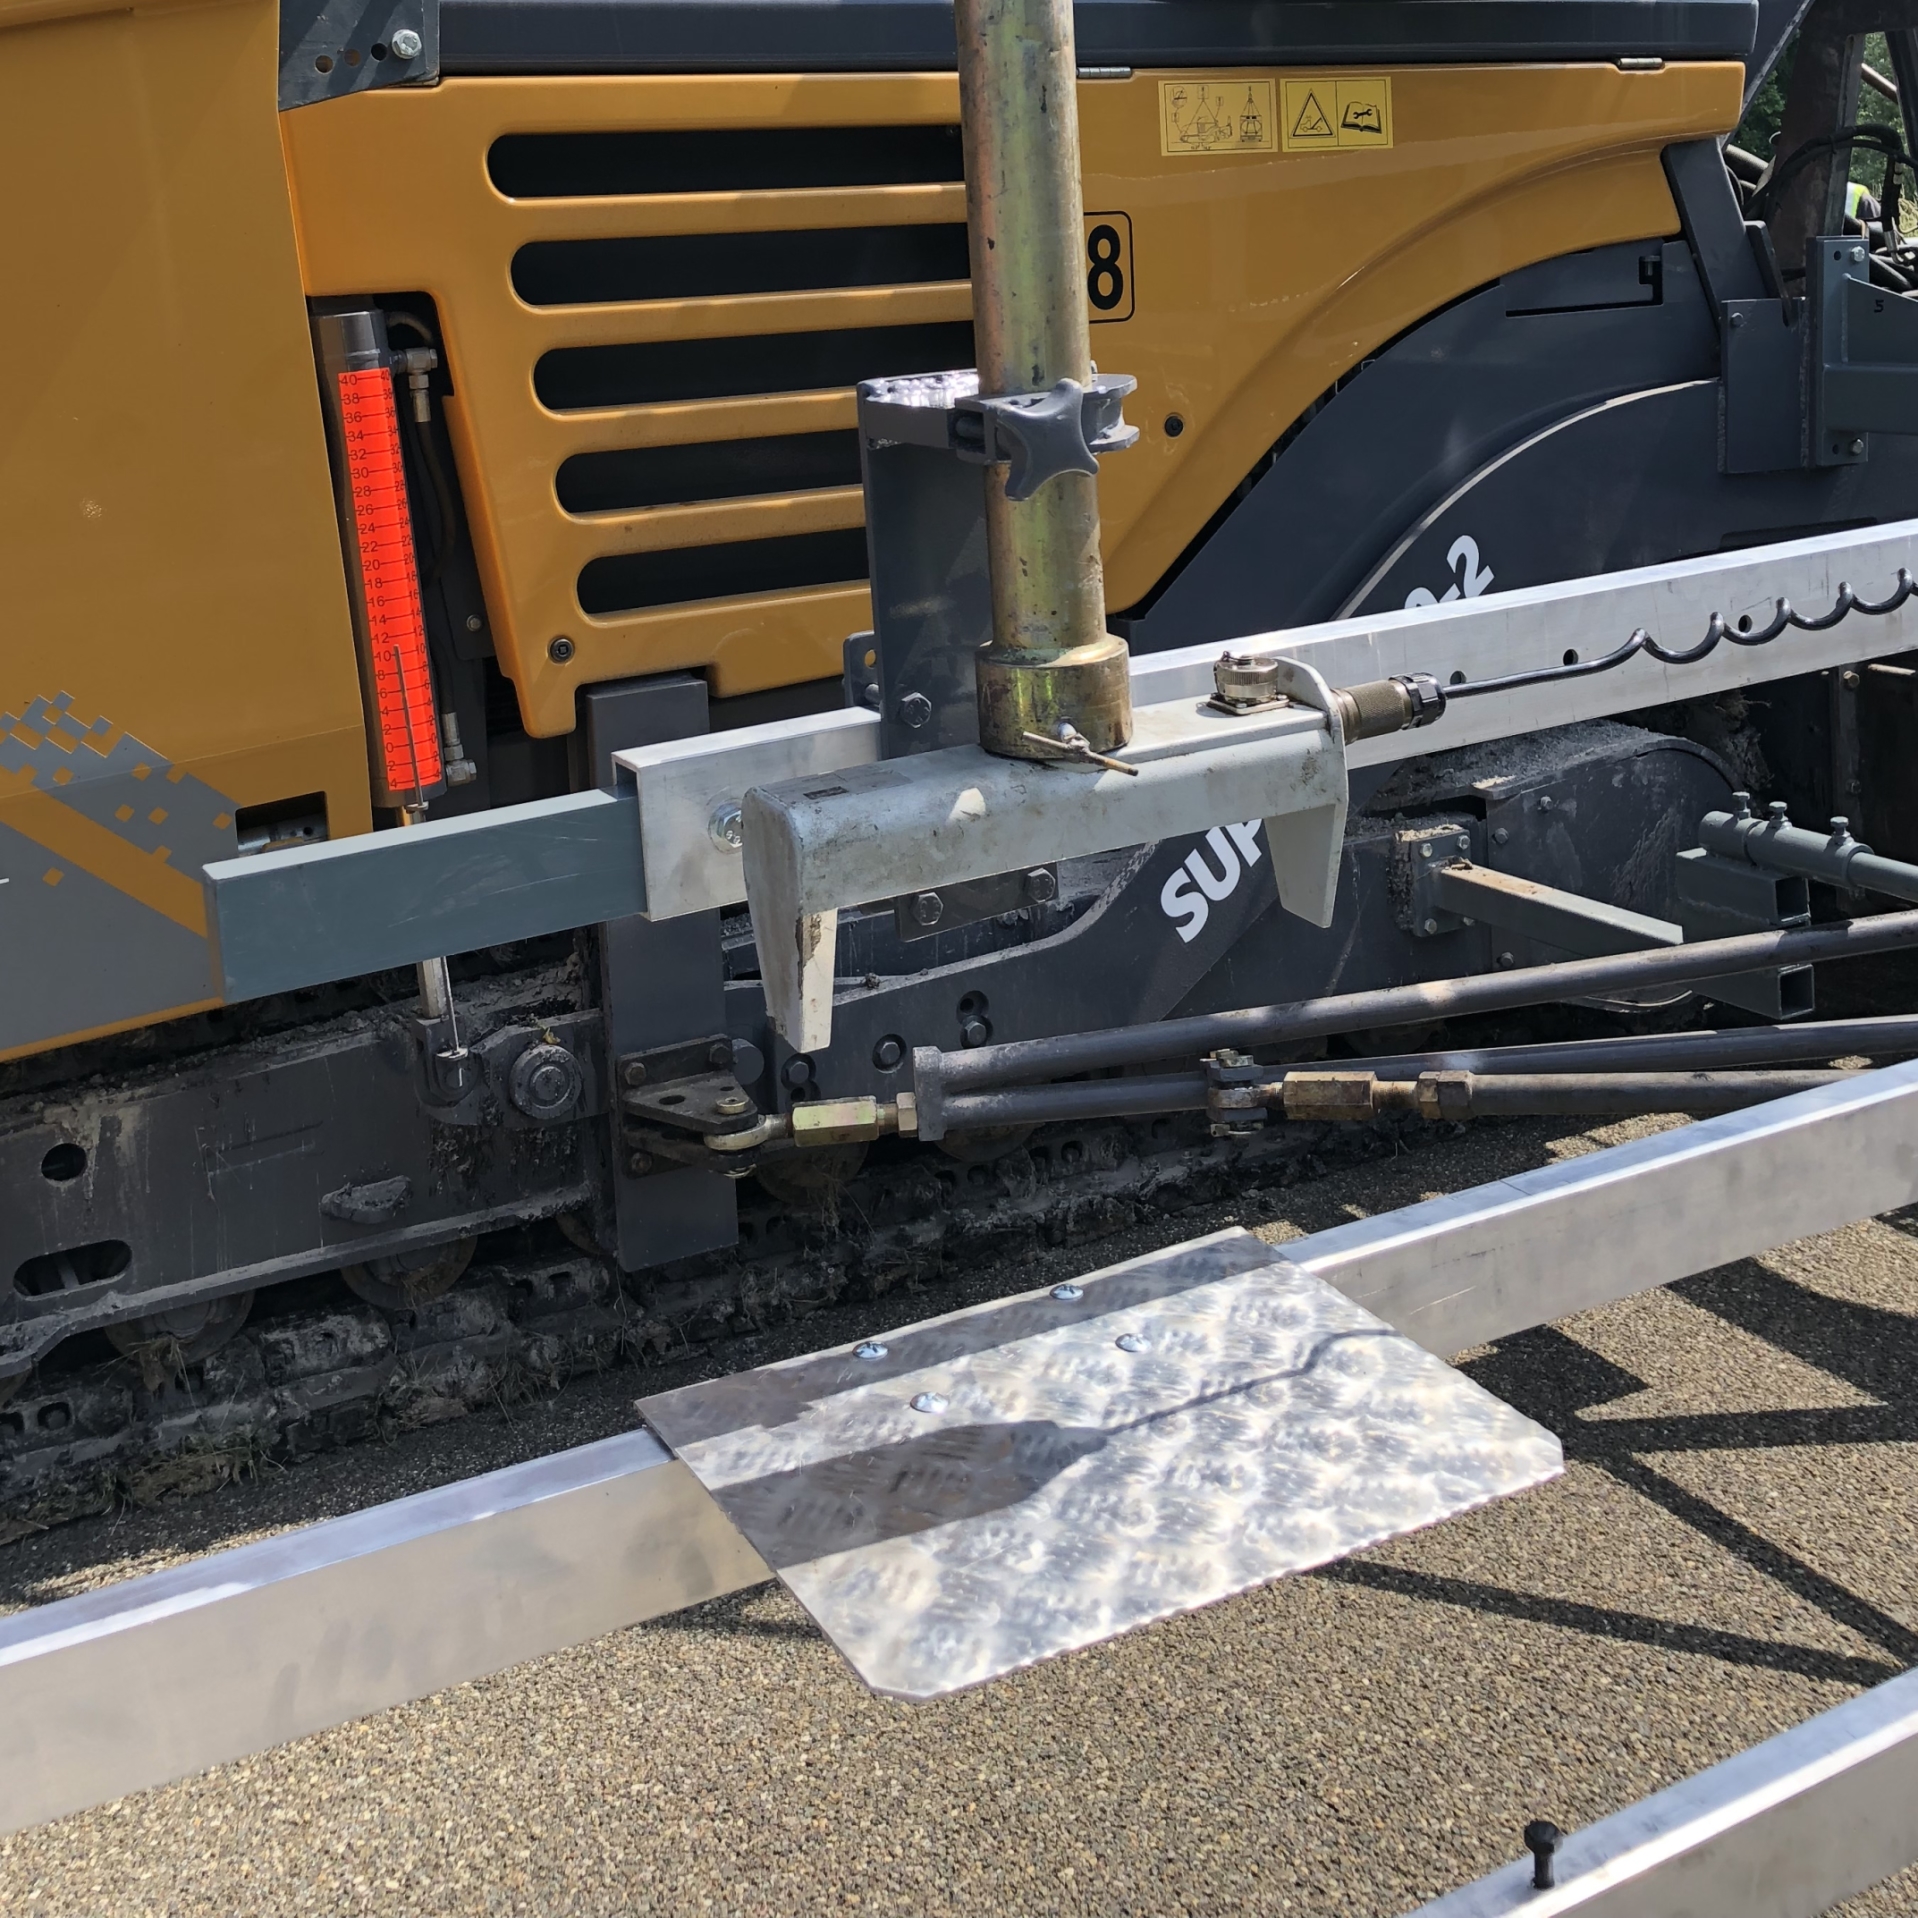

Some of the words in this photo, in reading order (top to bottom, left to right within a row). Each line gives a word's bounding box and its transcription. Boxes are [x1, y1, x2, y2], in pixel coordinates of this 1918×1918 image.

[1087, 224, 1124, 310] 8
[340, 375, 357, 386] 40
[343, 393, 360, 405] 38
[346, 411, 362, 423] 36
[348, 430, 364, 442] 34
[351, 448, 367, 461] 32
[352, 467, 369, 479] 30
[354, 485, 371, 498] 28
[357, 503, 374, 516] 26
[360, 522, 375, 534] 24
[362, 541, 378, 553] 22
[364, 559, 380, 571] 20
[367, 577, 383, 590] 18
[369, 595, 385, 607] 16
[372, 614, 387, 626] 14
[374, 632, 389, 644] 12
[376, 650, 391, 662] 10
[377, 669, 385, 680] 8
[379, 687, 387, 699] 6
[381, 706, 389, 717] 4
[384, 724, 391, 735] 2
[386, 742, 394, 753] 0
[388, 760, 396, 771] 2
[390, 778, 397, 788] 4
